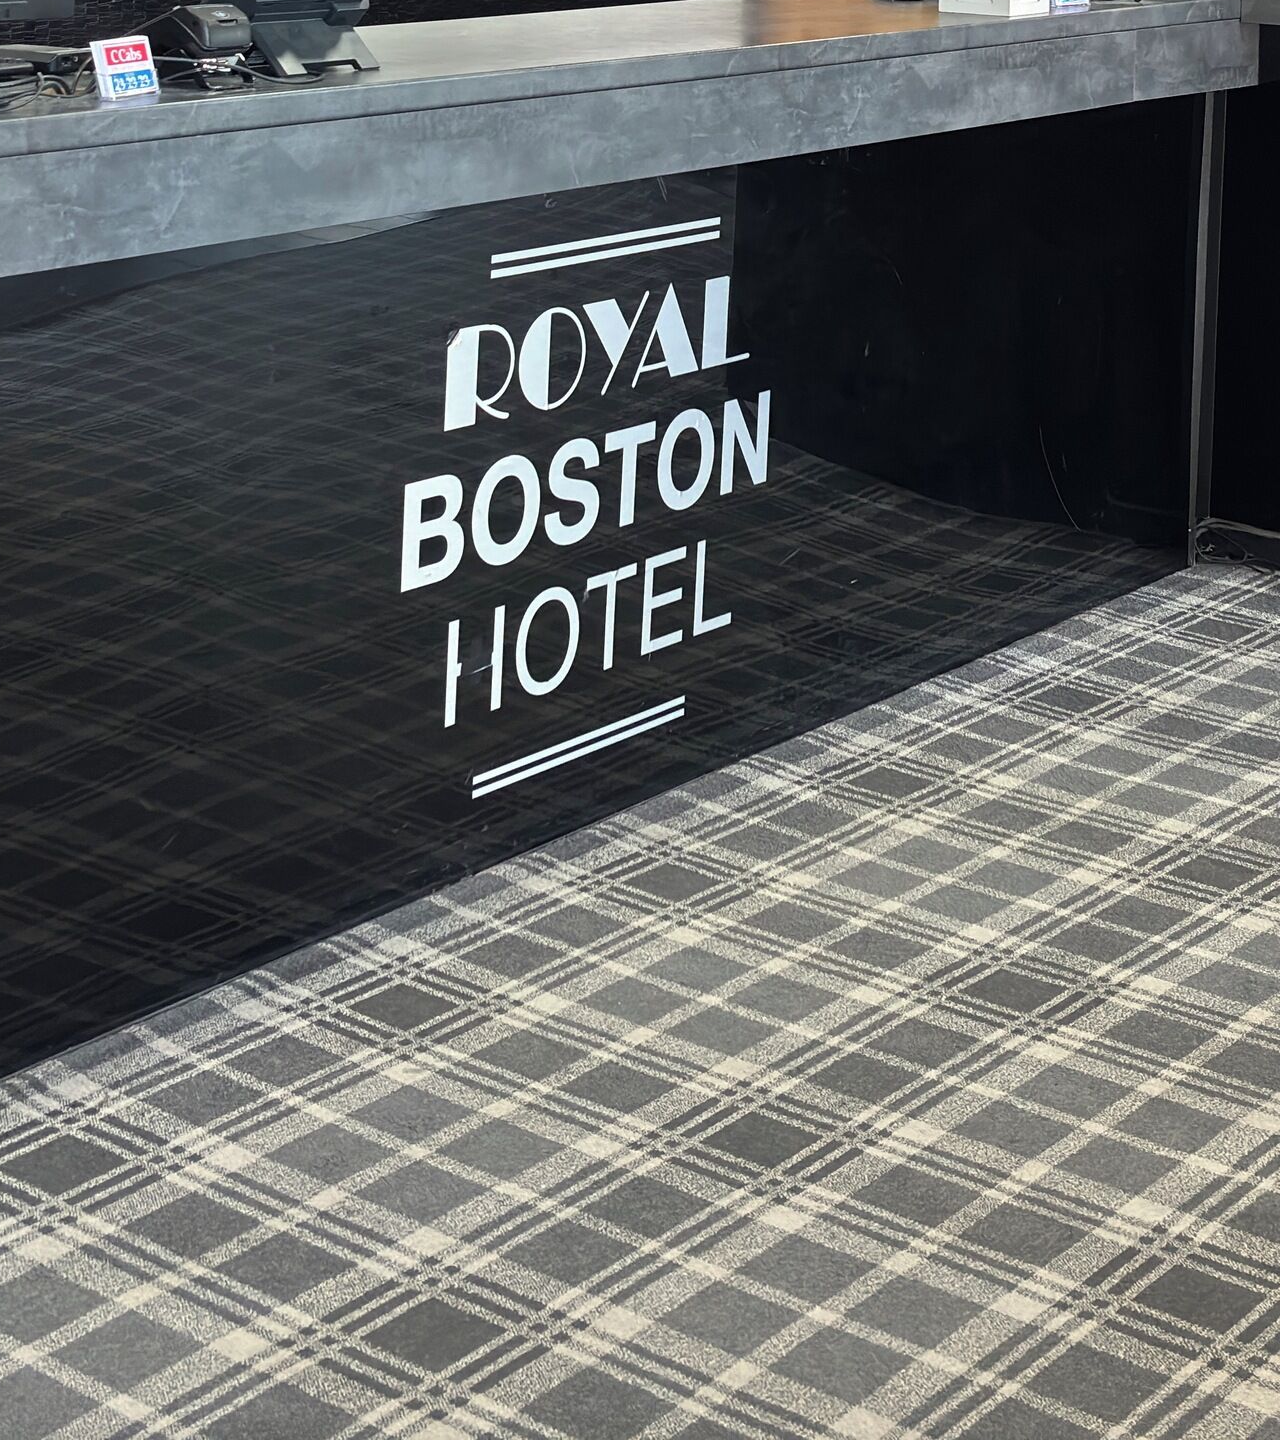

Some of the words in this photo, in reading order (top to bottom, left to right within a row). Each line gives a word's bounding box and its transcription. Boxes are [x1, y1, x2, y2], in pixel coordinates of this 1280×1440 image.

[443, 275, 750, 432] ROYAL
[401, 390, 771, 593] BOSTON
[444, 540, 732, 728] HOTEL
